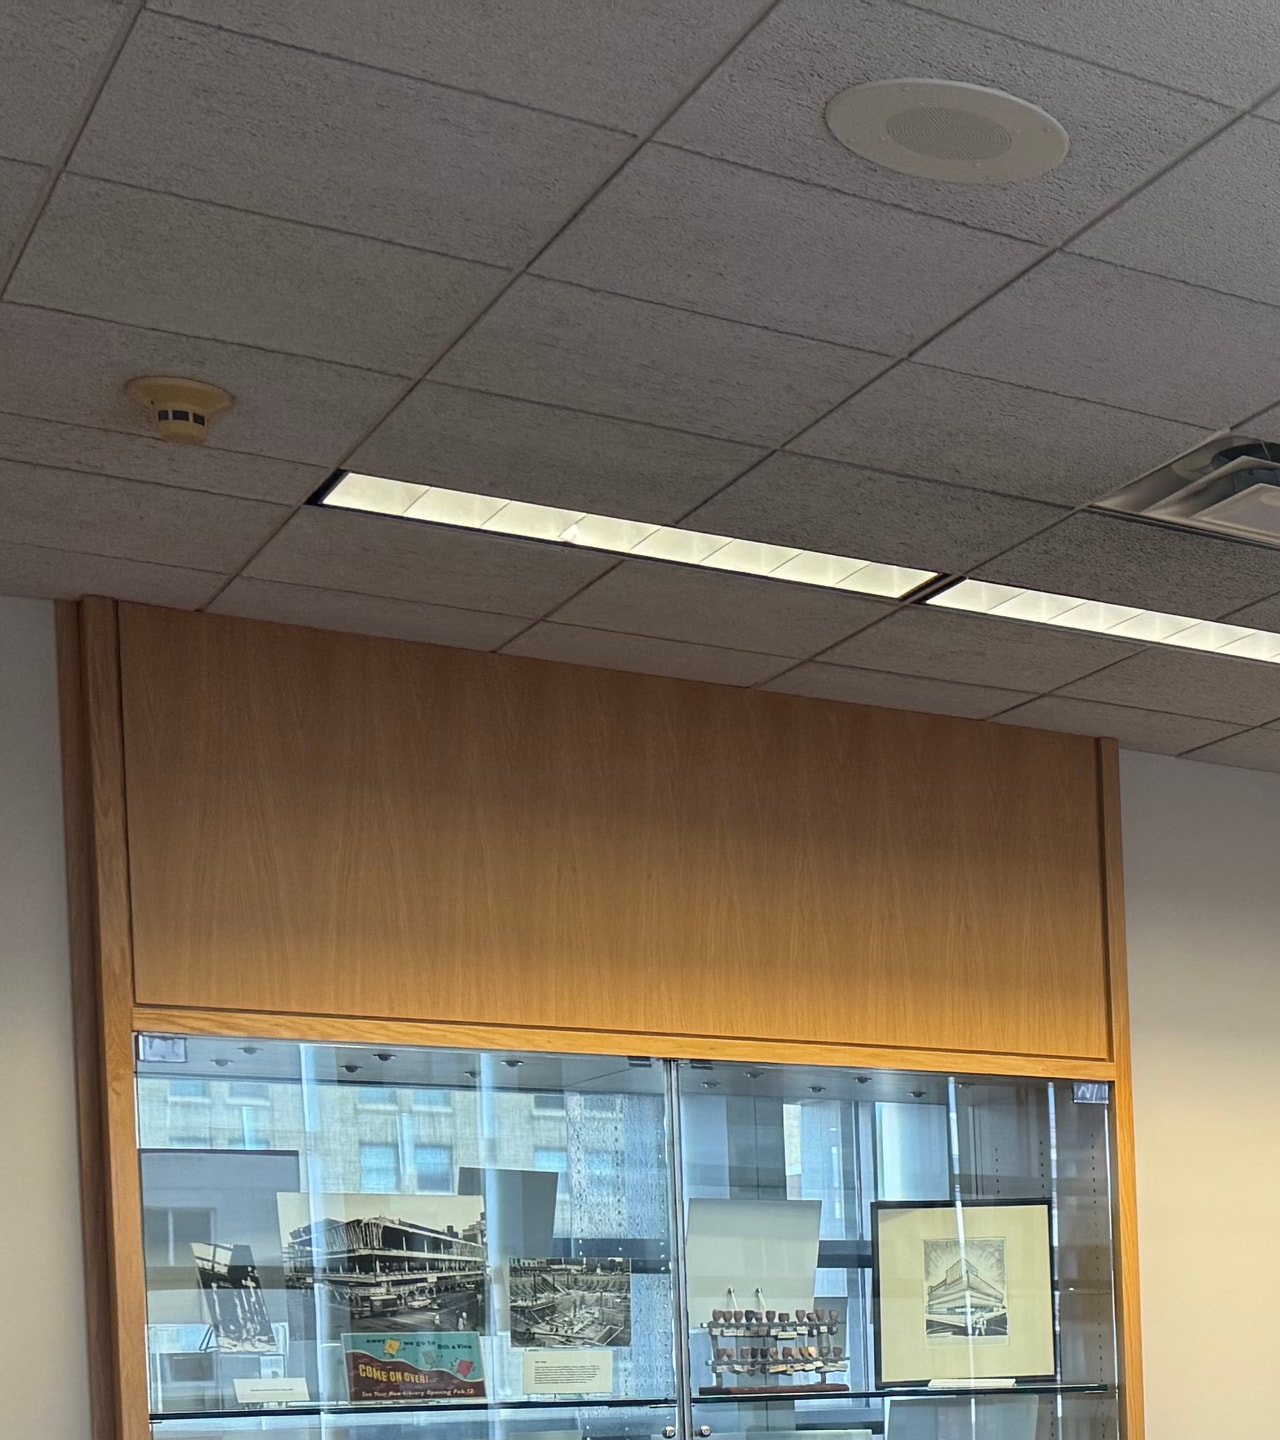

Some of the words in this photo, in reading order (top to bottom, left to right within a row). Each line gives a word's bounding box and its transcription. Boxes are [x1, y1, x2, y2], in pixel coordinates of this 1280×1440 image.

[358, 1364, 388, 1381] COME
[389, 1371, 402, 1382] ON
[403, 1372, 429, 1384] OVER!
